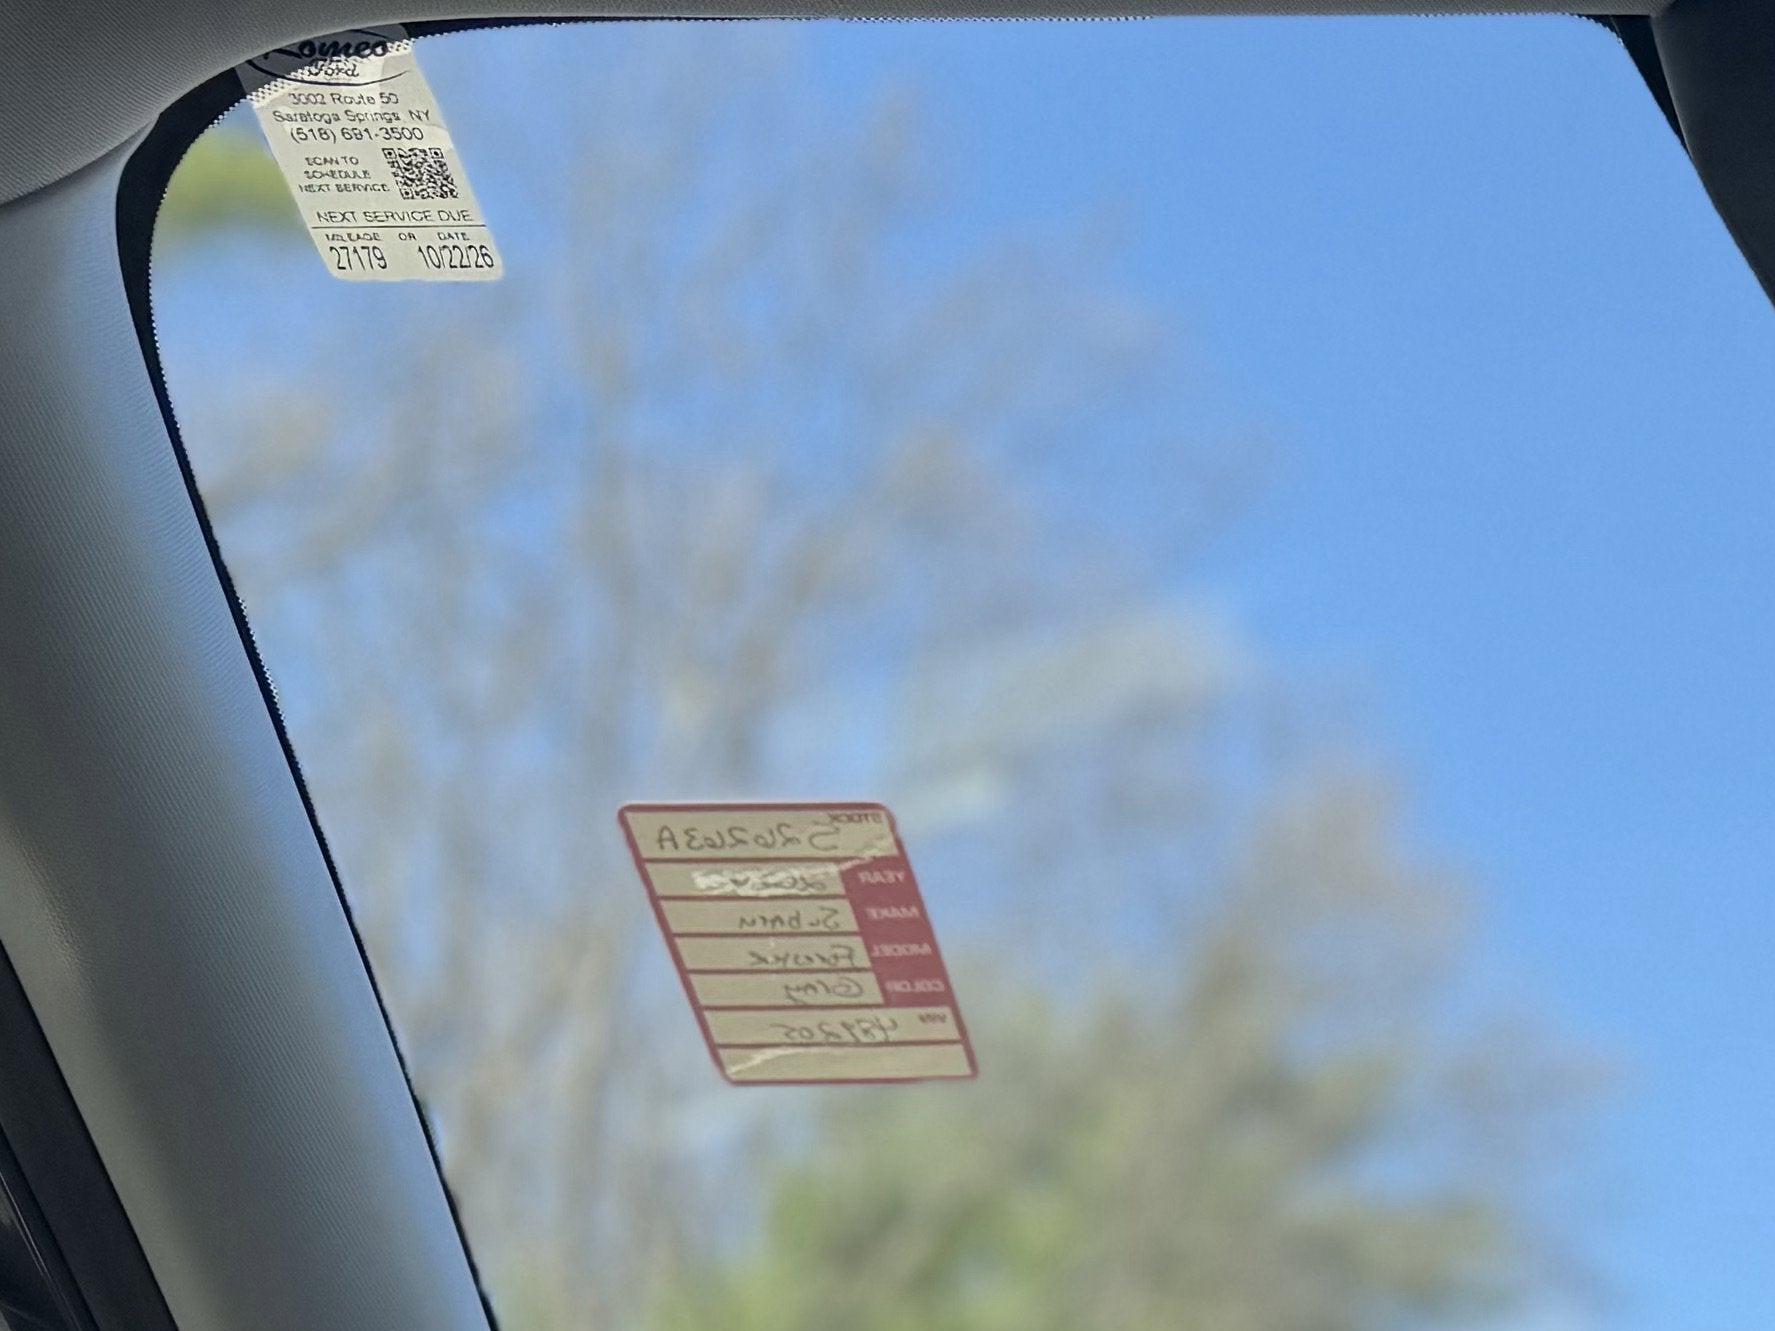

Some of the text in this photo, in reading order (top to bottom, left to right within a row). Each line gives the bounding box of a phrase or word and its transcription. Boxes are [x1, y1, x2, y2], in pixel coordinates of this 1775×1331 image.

[330, 92, 375, 105] Route
[379, 92, 399, 104] 50
[272, 110, 341, 124] Saratoga
[408, 109, 430, 121] NY
[290, 127, 337, 144] (518)
[305, 156, 359, 166] SCAN TO
[299, 183, 390, 193] NEXT SERVICE
[317, 209, 474, 223] NEXT SERVICE DUE
[437, 232, 470, 241] DATE
[329, 244, 494, 271] 27179 10/22/26
